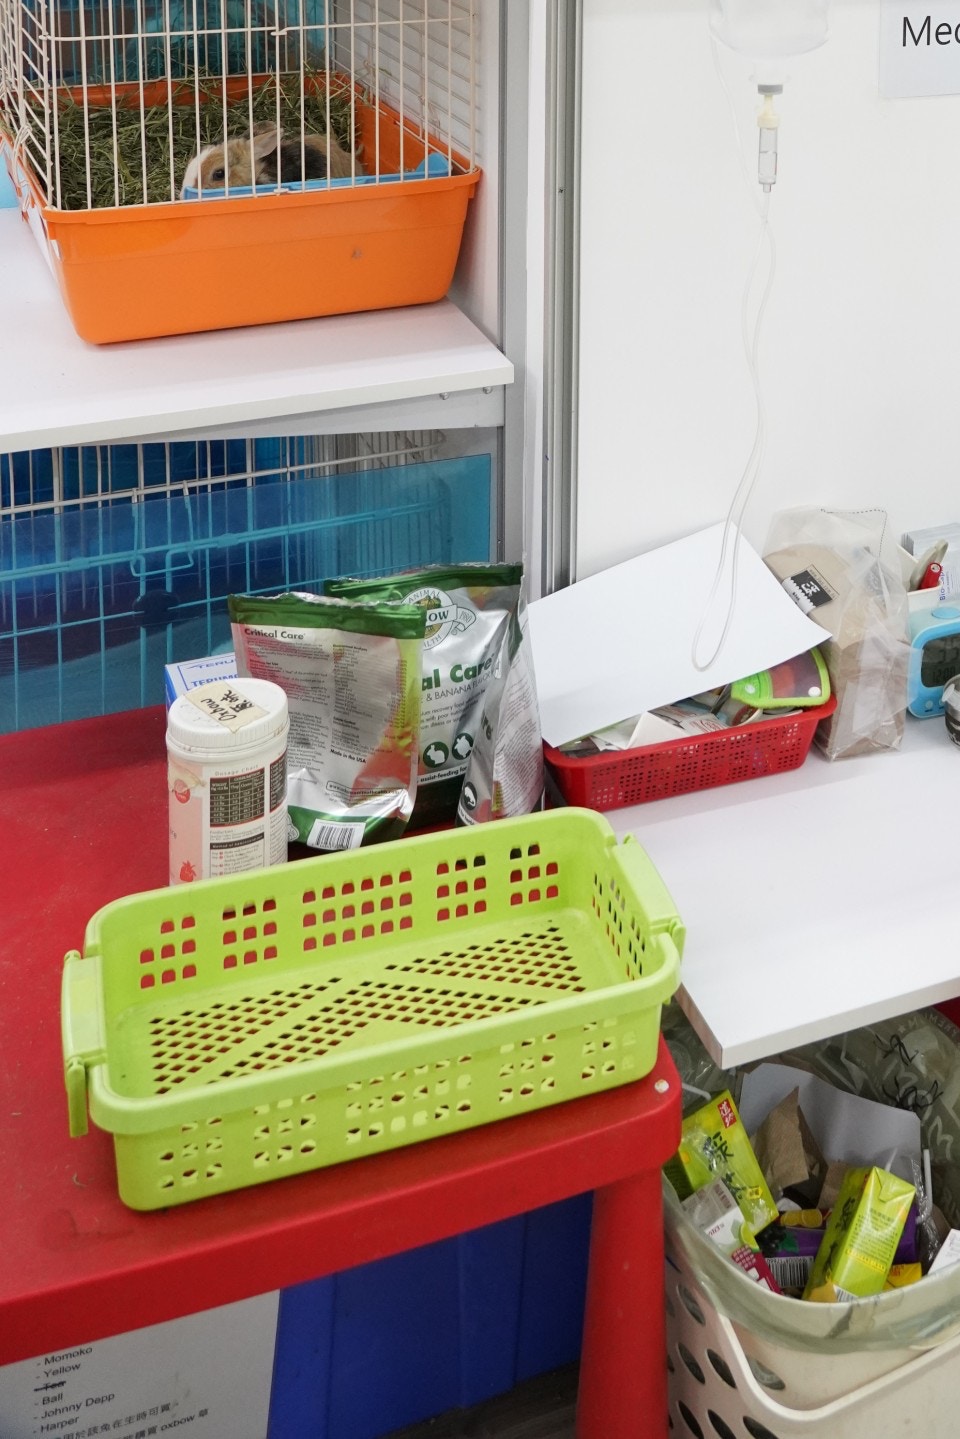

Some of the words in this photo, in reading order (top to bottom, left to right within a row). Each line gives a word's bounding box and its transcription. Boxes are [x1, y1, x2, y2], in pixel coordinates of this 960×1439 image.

[408, 589, 440, 602] ANIMAL
[244, 628, 277, 638] Critical
[280, 630, 304, 640] Care
[450, 657, 492, 683] Care
[426, 693, 433, 702] &
[434, 684, 472, 700] BANANA
[432, 705, 453, 714] recovery
[330, 749, 342, 758] Made
[356, 755, 366, 764] USA
[420, 768, 459, 783] assist-feeding
[44, 1347, 93, 1366] Momoko
[43, 1362, 81, 1378] Yellow
[41, 1402, 82, 1419] Johnny
[85, 1393, 115, 1407] Depp
[42, 1392, 63, 1405] Ball
[40, 1416, 80, 1433] Harper
[160, 1415, 196, 1431] oxbow
